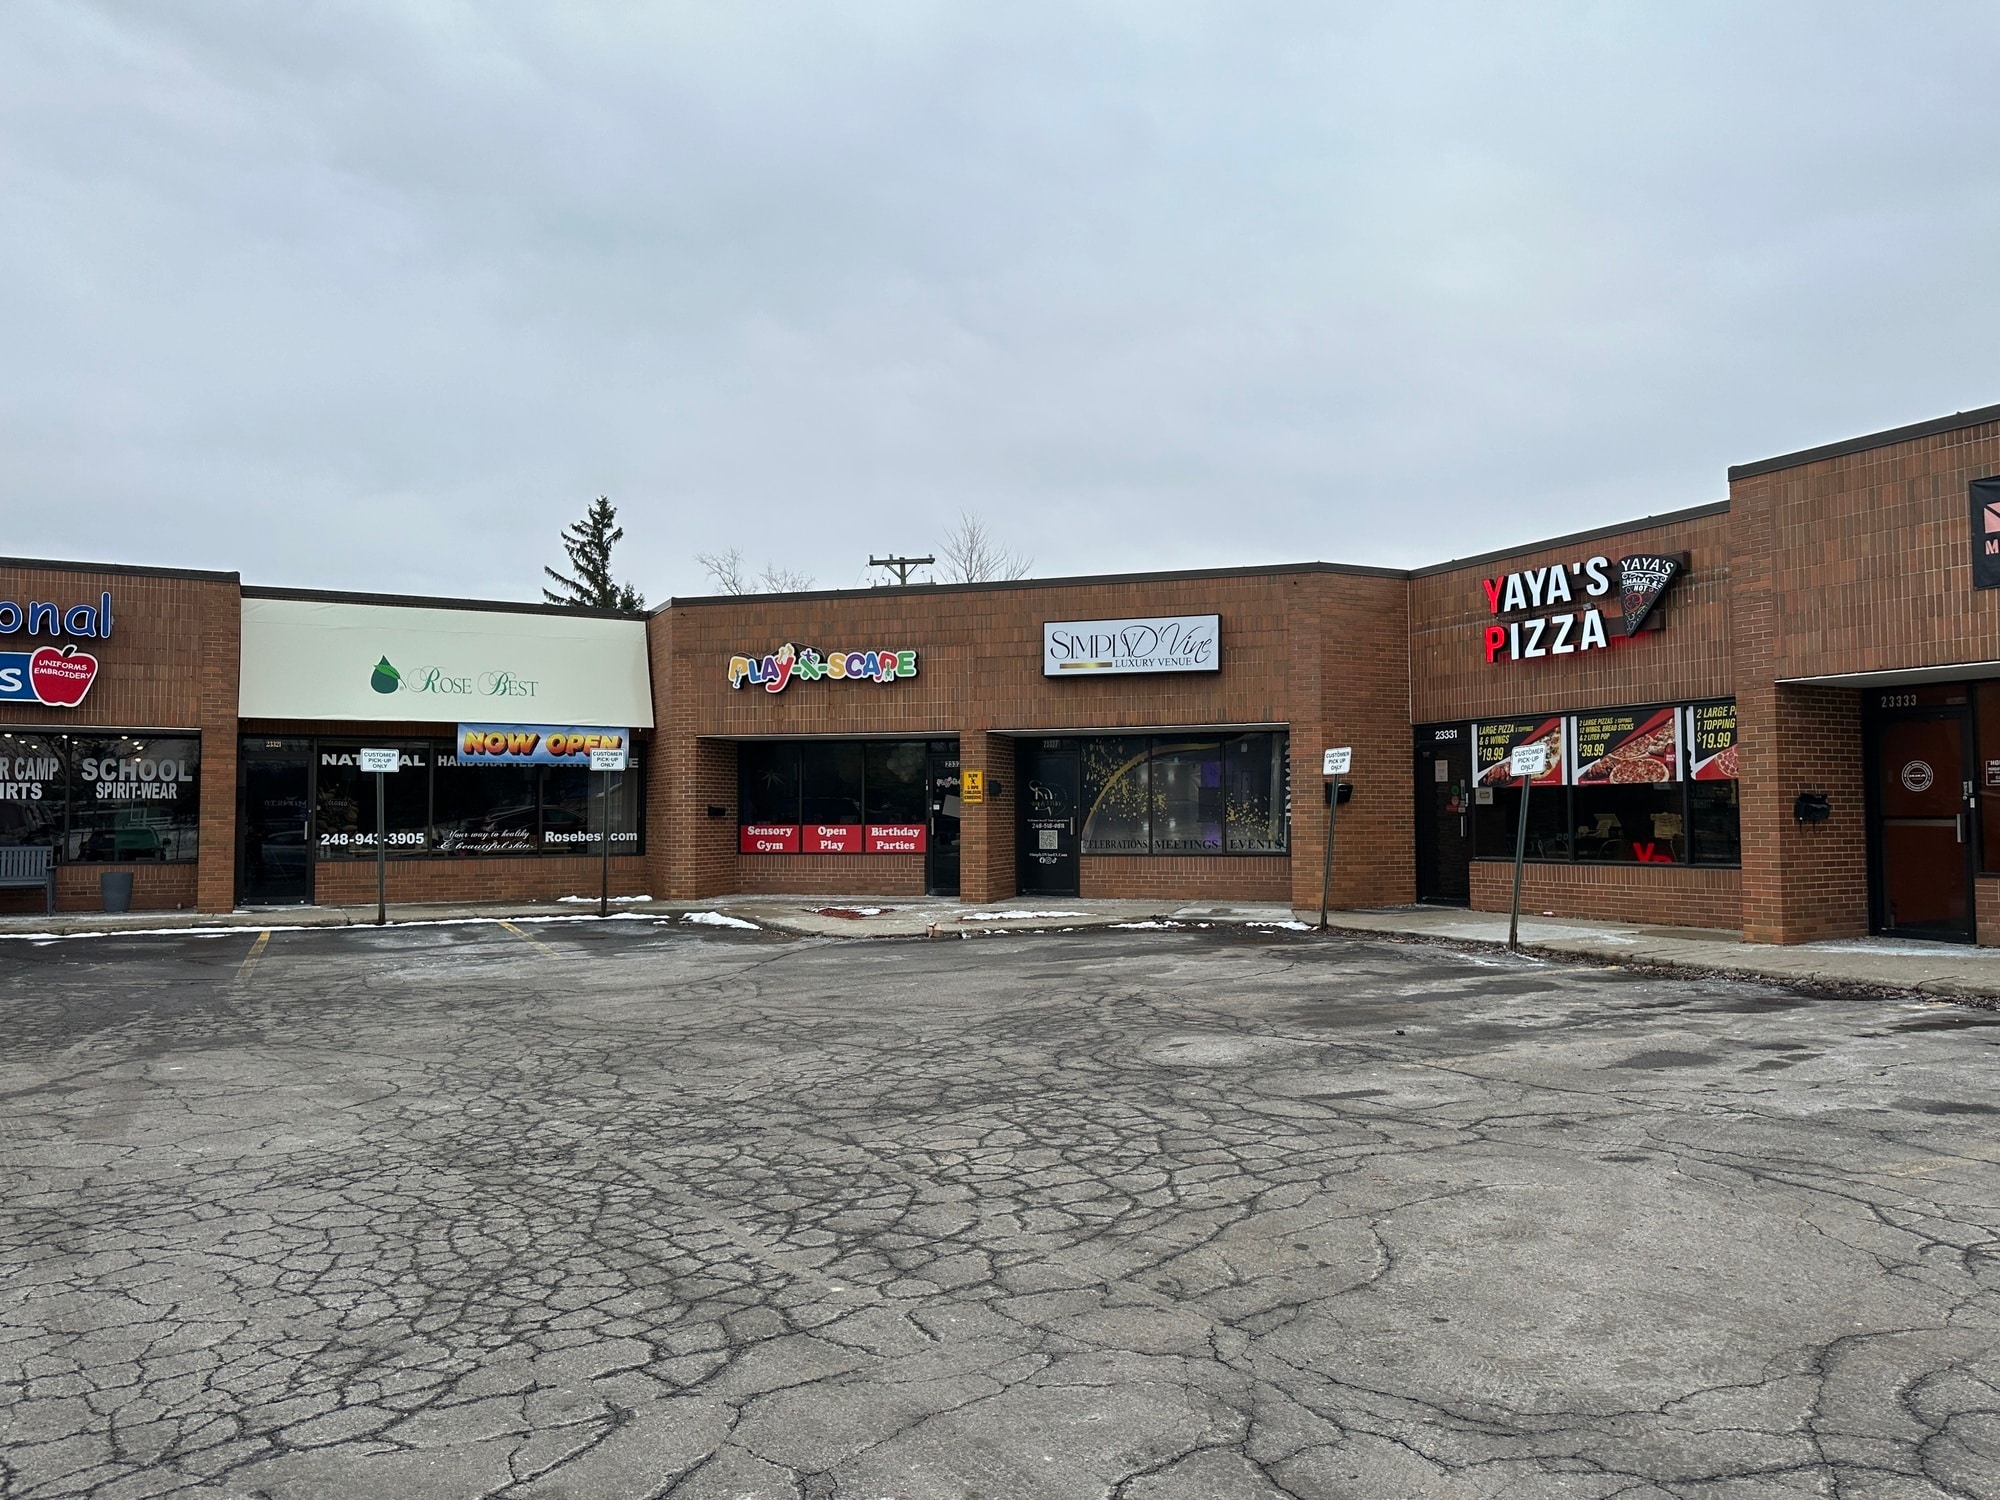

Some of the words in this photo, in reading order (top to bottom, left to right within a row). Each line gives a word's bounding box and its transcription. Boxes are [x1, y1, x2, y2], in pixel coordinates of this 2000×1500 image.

[1621, 558, 1674, 574] YAYA'S
[1482, 556, 1609, 614] YAYA'S
[1484, 609, 1607, 663] PIZZA
[1050, 630, 1136, 660] SIMPLY
[39, 660, 87, 671] UNIFORMS
[1115, 658, 1155, 668] LUXURY
[1158, 657, 1192, 667] VENUE
[34, 667, 92, 679] EMBROIDERY
[1881, 694, 1917, 708] 23333
[1696, 708, 1702, 718] 2
[1703, 706, 1728, 718] LARGE
[1597, 717, 1613, 725] PIZZAS
[1697, 721, 1701, 730] 1
[1703, 718, 1736, 730] TOPPING
[1479, 725, 1497, 735] LARGE
[1498, 724, 1514, 734] PIZZA
[1602, 724, 1617, 732] BREAD
[1618, 723, 1634, 731] STICKS
[1435, 729, 1457, 740] 23331
[1479, 737, 1484, 745] &
[1485, 737, 1489, 745] 6
[1490, 735, 1509, 744] WINGS
[1696, 732, 1731, 749] $19.99
[463, 732, 540, 756] NOW
[545, 733, 623, 757] OPEN
[1579, 743, 1604, 757] $39.99
[1326, 751, 1350, 759] CUSTOMER
[1479, 747, 1504, 761] $19.99
[1514, 747, 1544, 757] CUSTOMER
[321, 753, 425, 767] NATAL
[1517, 755, 1540, 763] PICK-UP
[0, 757, 9, 780] R
[14, 757, 59, 781] CAMP
[81, 758, 192, 782] SCHOOL
[1520, 763, 1535, 771] ONLY
[96, 782, 177, 799] SPIRIT-WEAR
[444, 829, 468, 842] Your
[470, 832, 488, 841] way
[491, 831, 499, 839] to
[501, 829, 530, 840] healthy
[747, 826, 793, 837] Sensory
[817, 826, 847, 837] Open
[871, 827, 921, 838] Birthday
[437, 840, 451, 850] &
[455, 841, 506, 852] beautiful
[757, 840, 783, 851] Gym
[820, 840, 844, 851] Play
[876, 840, 915, 850] Parties
[1083, 839, 1148, 850] CELEBRATIONS
[1155, 839, 1219, 850] MEETINGS
[1230, 838, 1282, 850] EVENTS
